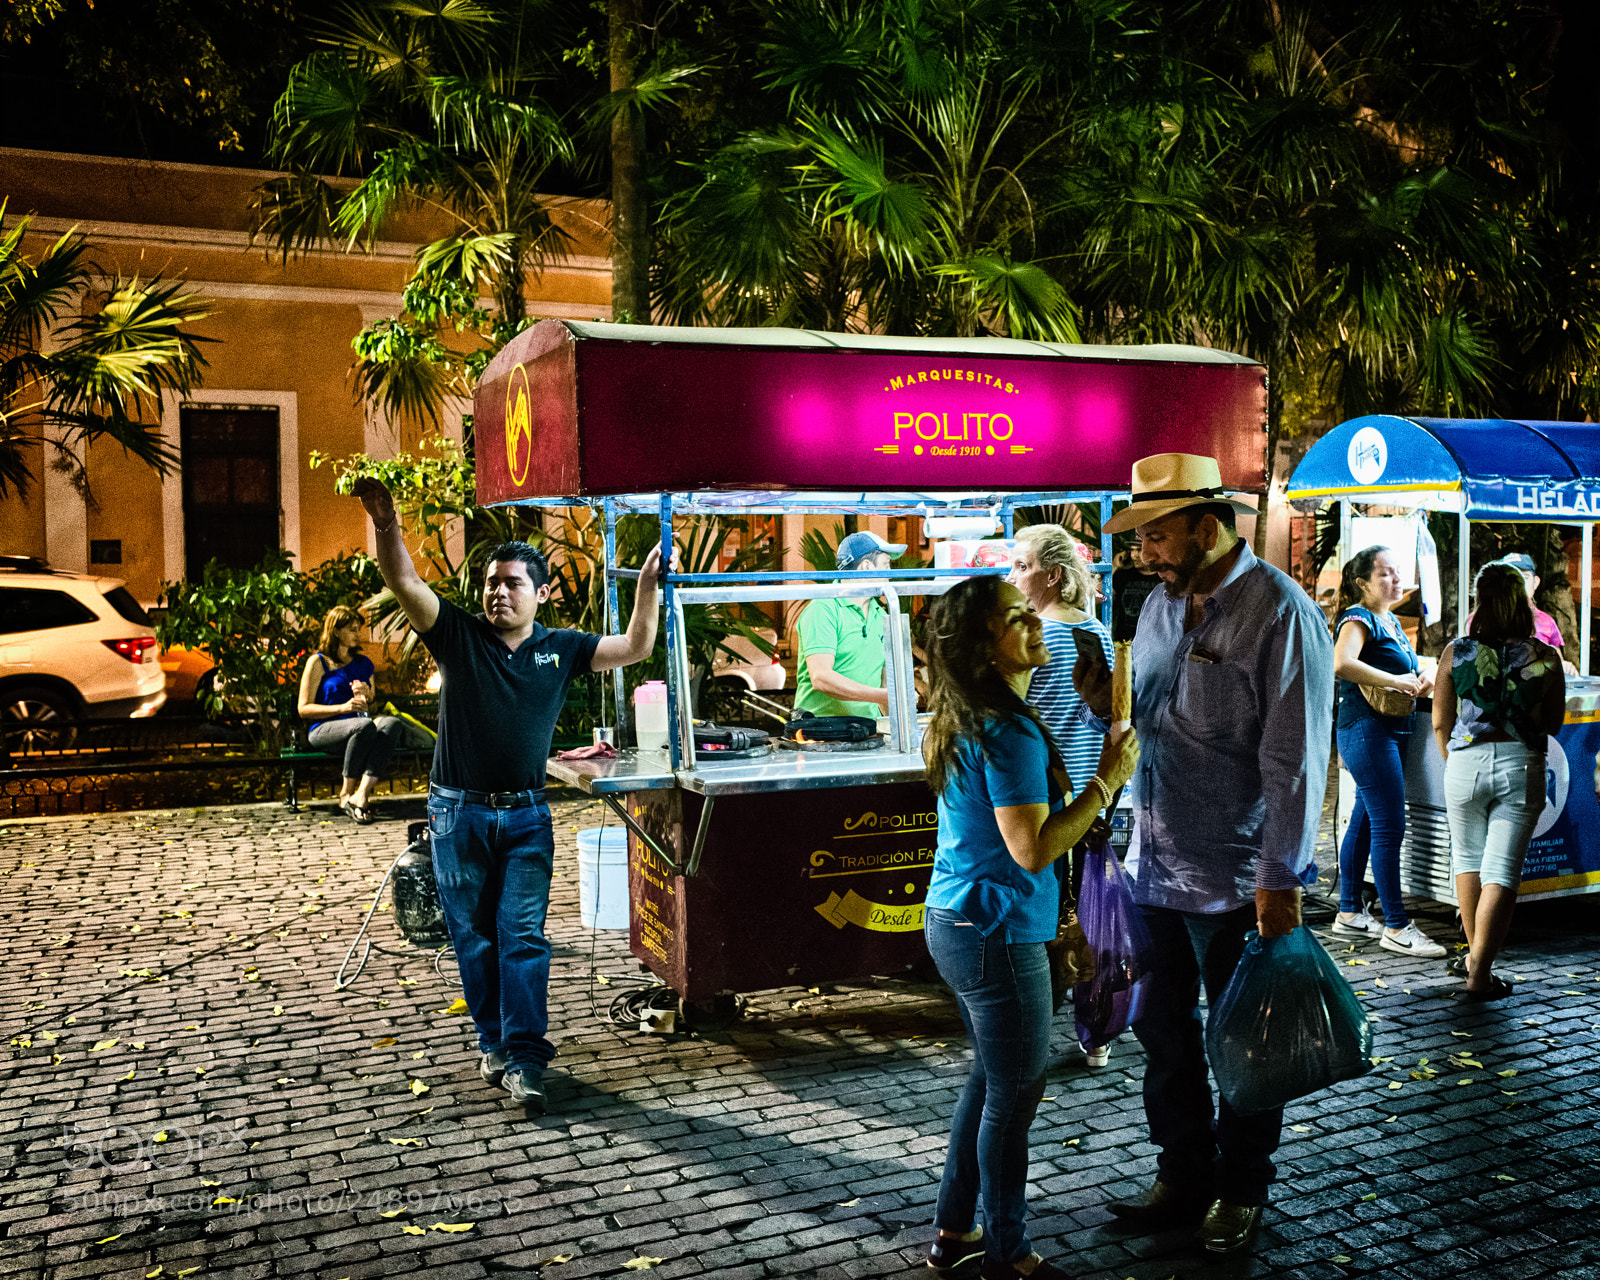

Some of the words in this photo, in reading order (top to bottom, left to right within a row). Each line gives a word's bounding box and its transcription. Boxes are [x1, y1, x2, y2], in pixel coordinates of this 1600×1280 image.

[889, 369, 1014, 393] MARQUESITAS
[893, 412, 1013, 441] POLITO
[930, 445, 957, 456] Desde
[959, 446, 981, 456] 1910
[879, 812, 938, 828] POLITO
[1532, 838, 1564, 848] FAMILIAR
[838, 850, 913, 868] TRADICIÓN
[870, 909, 912, 926] Desde
